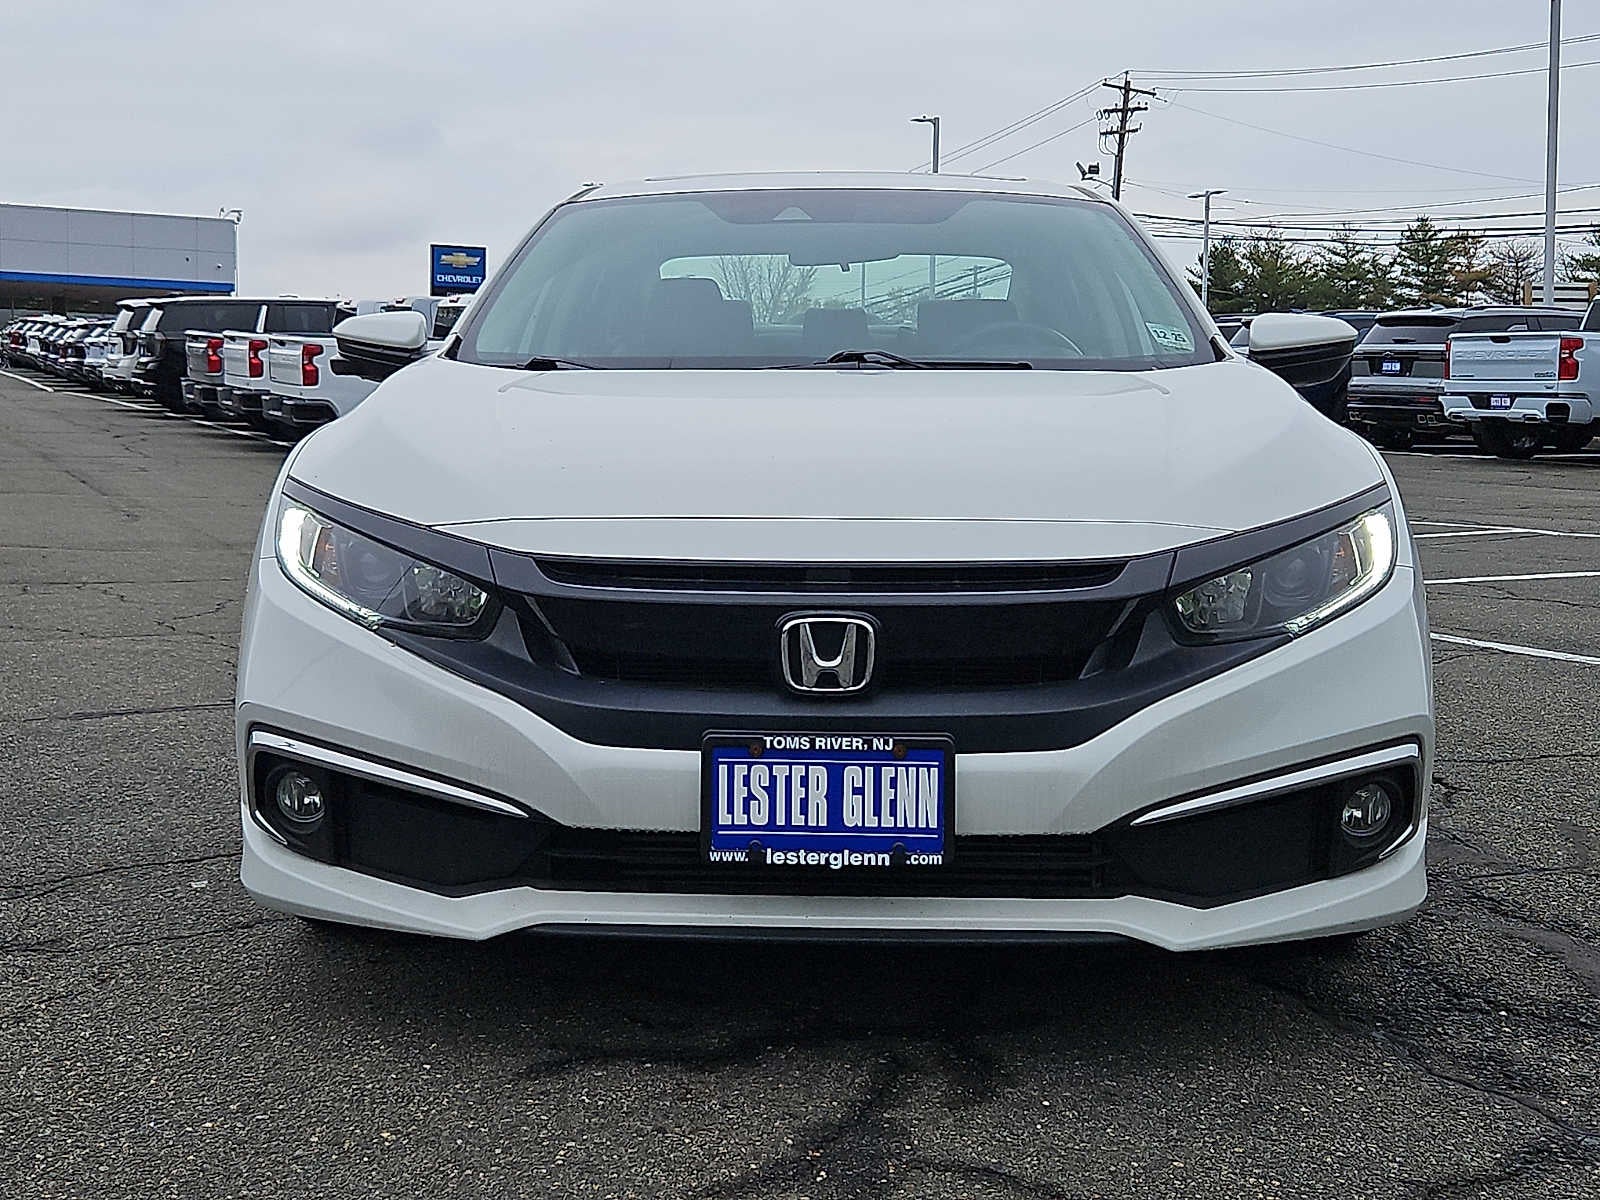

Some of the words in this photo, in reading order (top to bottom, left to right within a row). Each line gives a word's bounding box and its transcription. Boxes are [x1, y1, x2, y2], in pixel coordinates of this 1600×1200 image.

[436, 274, 483, 284] CHEVROLET
[763, 736, 810, 750] TOMS
[814, 736, 868, 751] RIVER,
[872, 737, 894, 751] NJ
[718, 764, 828, 827] LESTER
[843, 765, 938, 829] GLENN
[709, 850, 749, 862] www.
[766, 848, 890, 870] lesterglenn
[905, 851, 943, 865] .com
